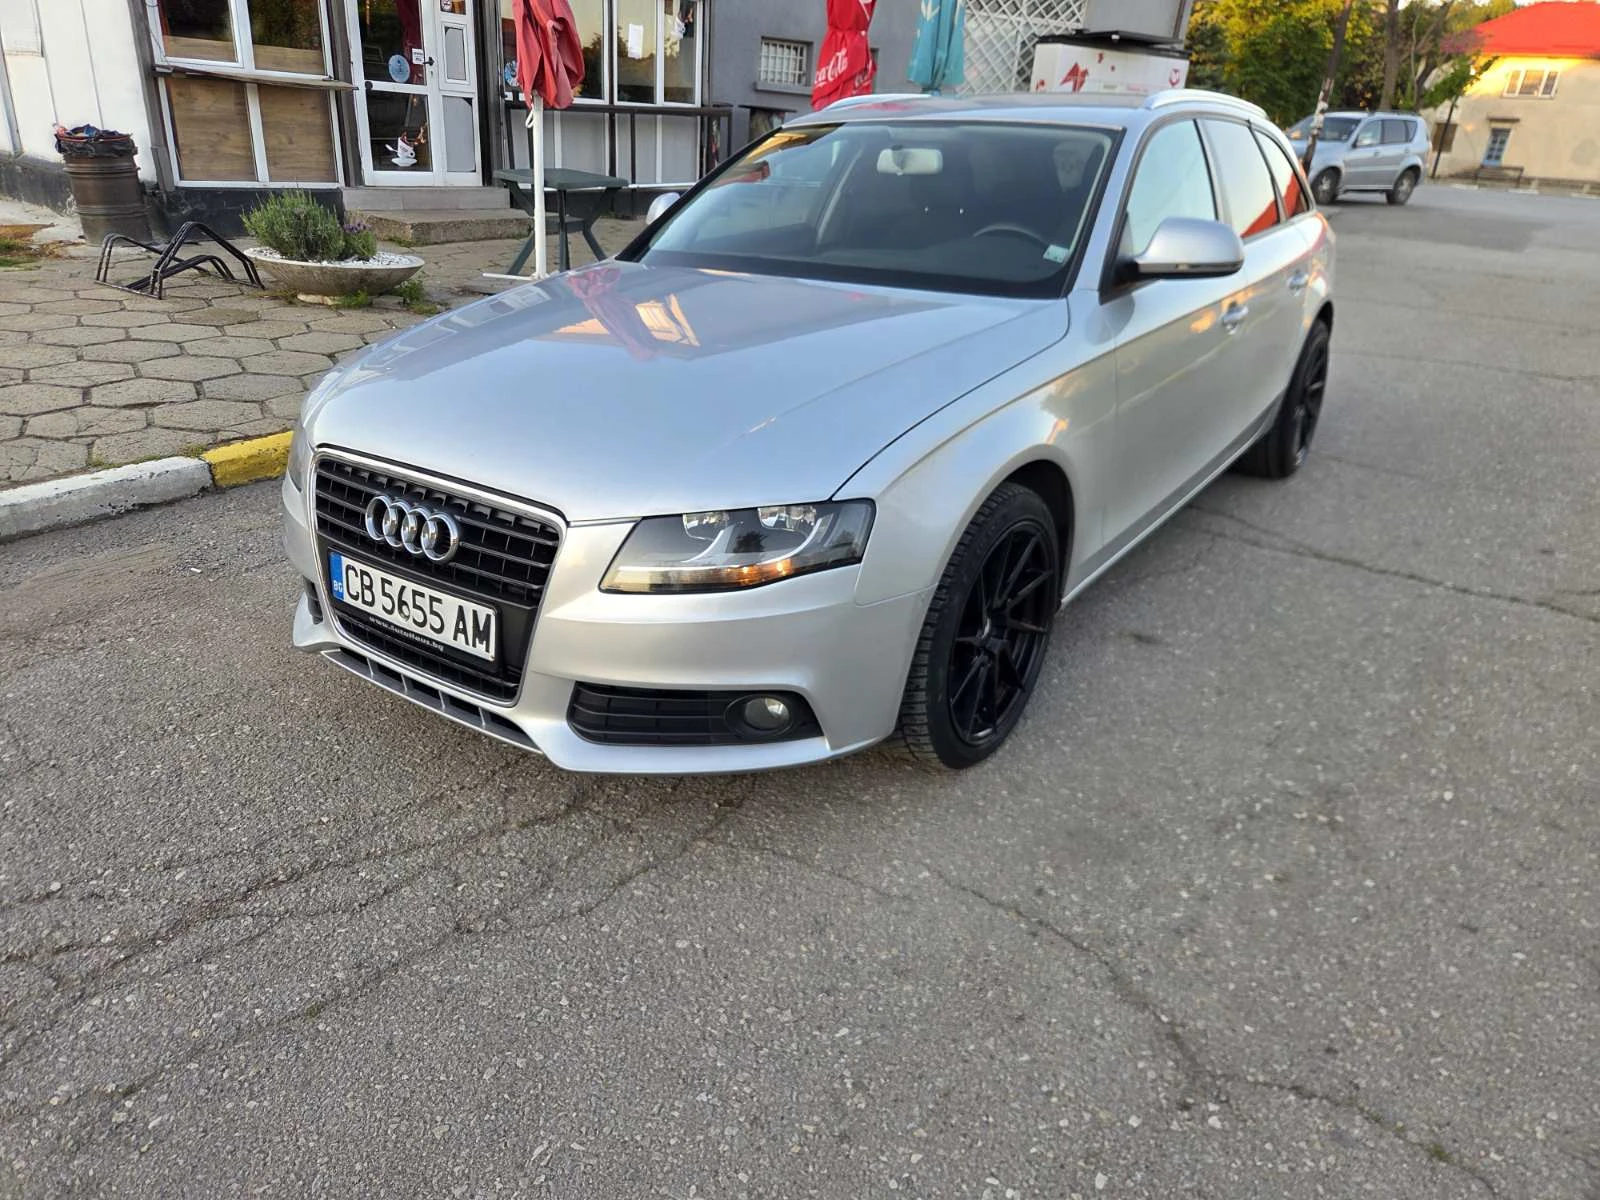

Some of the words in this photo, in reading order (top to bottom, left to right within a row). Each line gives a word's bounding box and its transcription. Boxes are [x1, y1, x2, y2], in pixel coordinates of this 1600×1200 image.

[333, 580, 343, 592] BG
[345, 564, 375, 607] CB
[380, 577, 445, 635] 5655
[453, 605, 492, 653] AM
